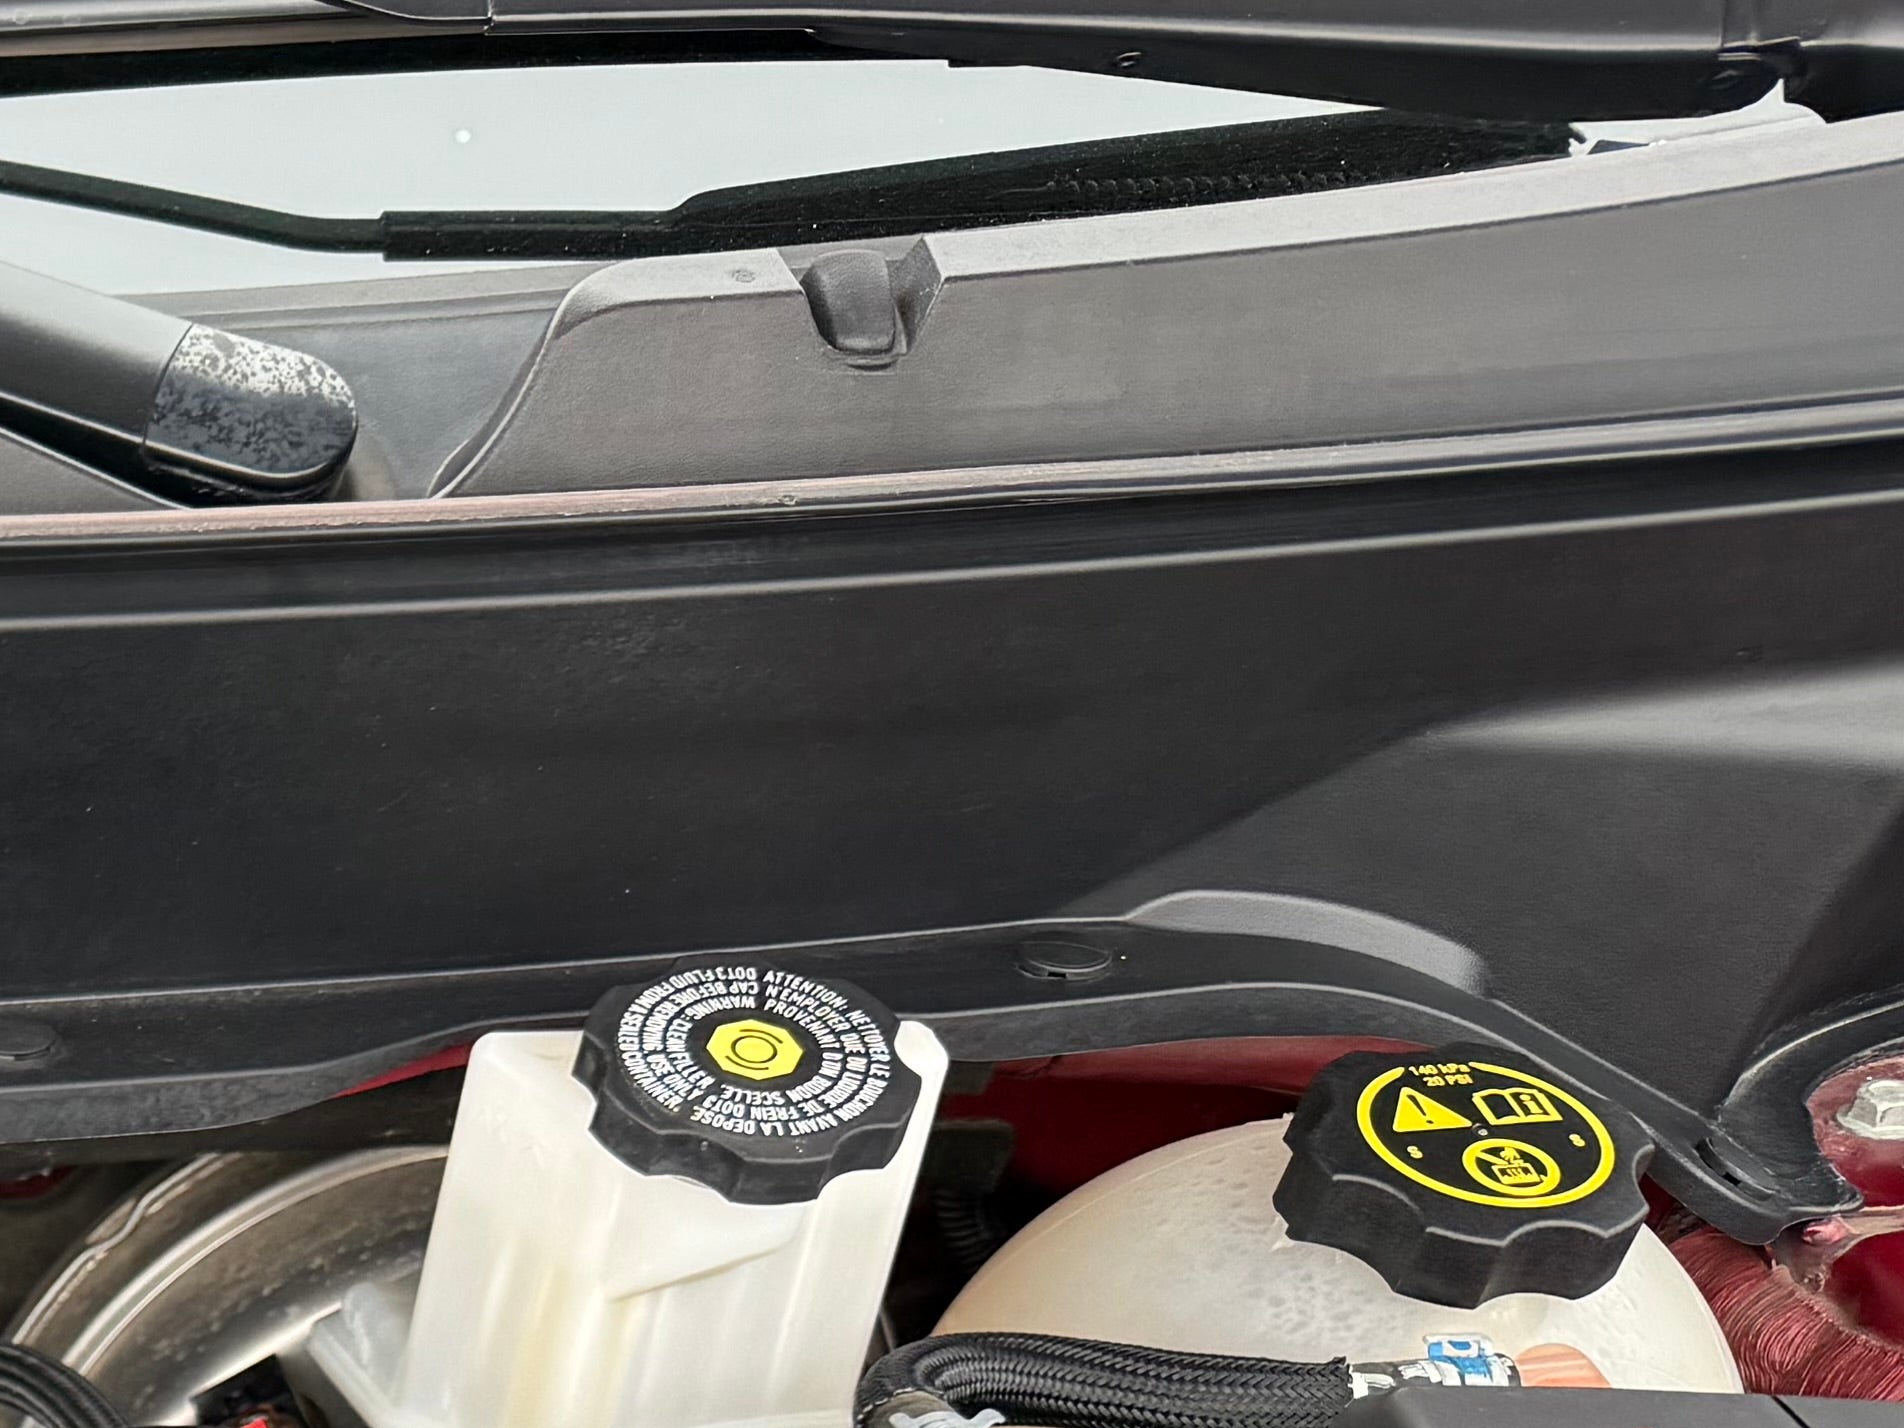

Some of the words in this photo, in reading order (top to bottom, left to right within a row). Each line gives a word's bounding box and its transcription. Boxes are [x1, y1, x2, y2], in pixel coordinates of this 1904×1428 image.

[669, 969, 715, 989] FLUID
[729, 981, 759, 994] CAP
[635, 982, 675, 1009] FROM
[669, 982, 728, 1008] BEFORE
[628, 1003, 648, 1014] A
[617, 1012, 644, 1051] SEALED
[666, 1018, 693, 1052] CLEAN
[763, 998, 841, 1049] PROVENANT
[845, 1010, 891, 1061] NETTOYER
[646, 1054, 675, 1076] USE
[667, 1052, 716, 1089] FILLER
[845, 1056, 867, 1072] DU
[869, 1063, 890, 1078] LE
[1409, 1064, 1436, 1076] 140
[663, 1073, 705, 1100] ONLY
[785, 1075, 833, 1103] BIDON
[817, 1071, 863, 1109] LIQUIDE
[1423, 1075, 1444, 1087] 20
[1445, 1073, 1473, 1086] PSI
[797, 1099, 825, 1116] DE
[833, 1077, 888, 1121] BOUCHON
[750, 1106, 800, 1121] FREIN
[789, 1113, 838, 1136] AVANT
[759, 1122, 784, 1136] LA
